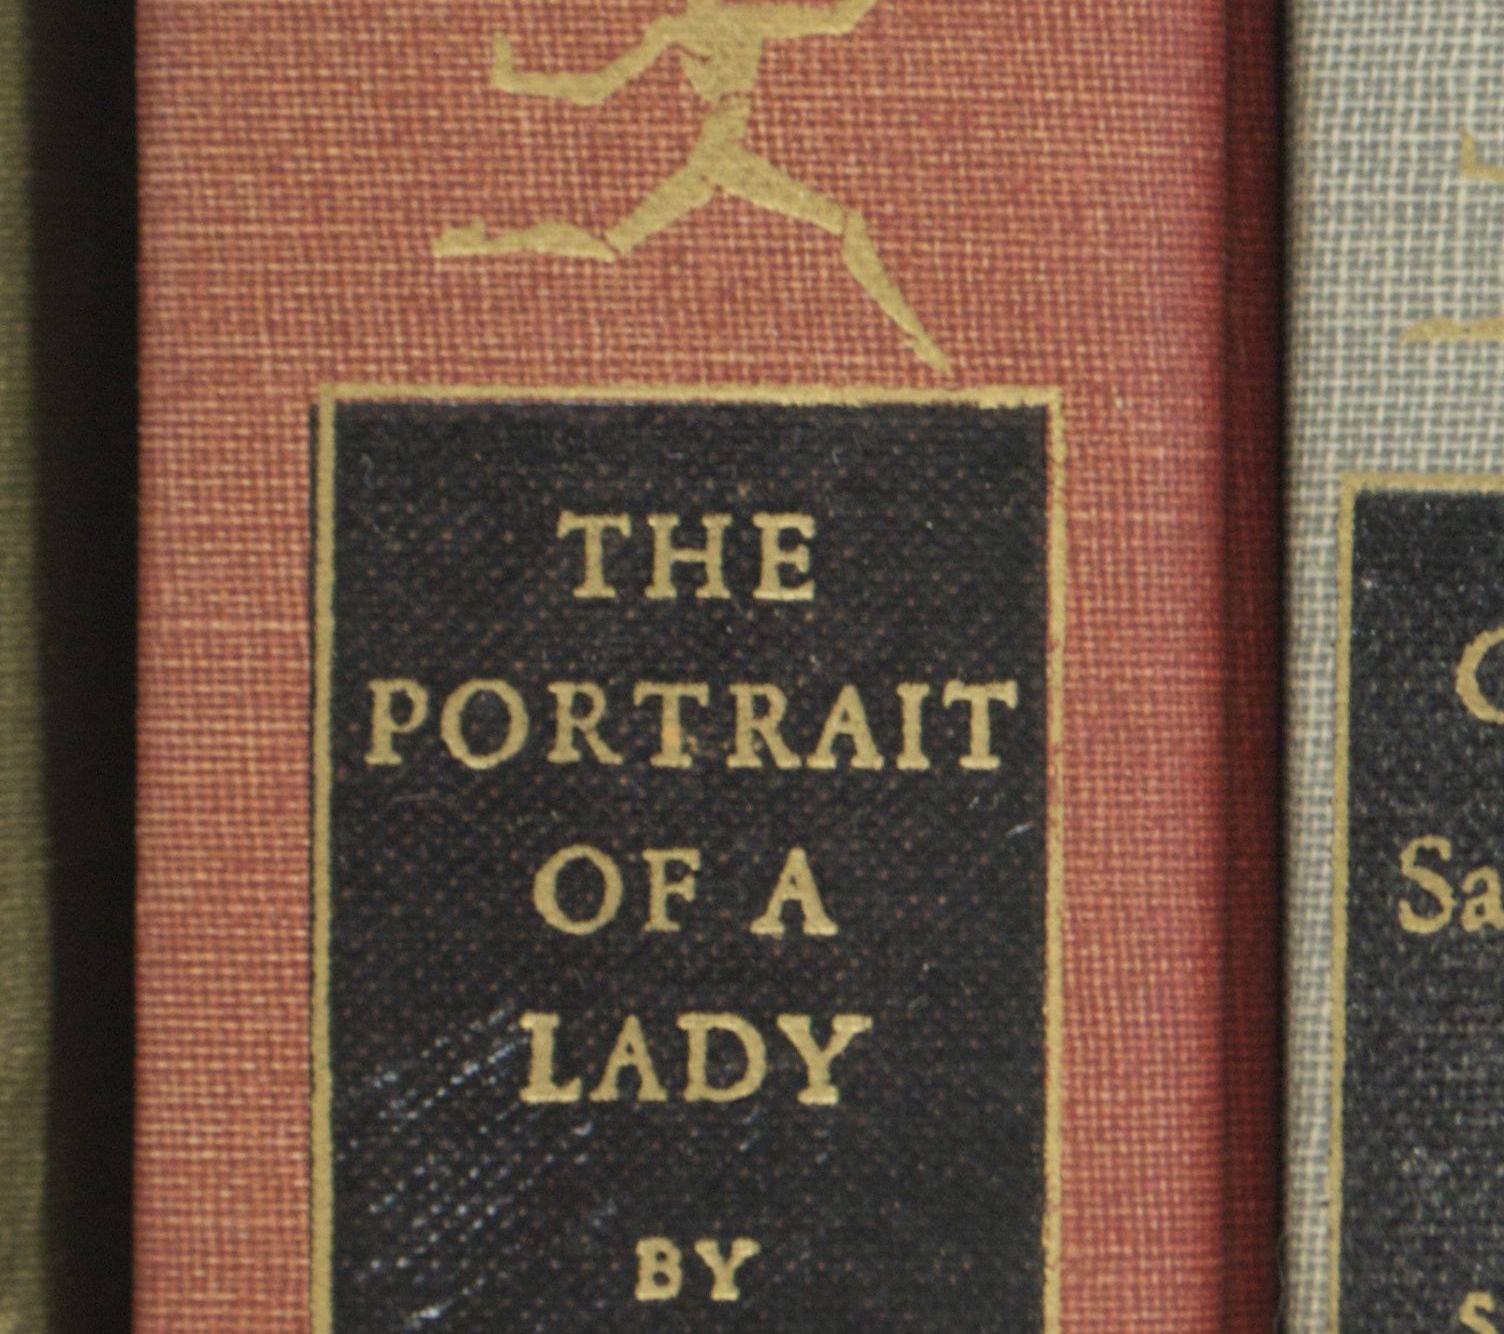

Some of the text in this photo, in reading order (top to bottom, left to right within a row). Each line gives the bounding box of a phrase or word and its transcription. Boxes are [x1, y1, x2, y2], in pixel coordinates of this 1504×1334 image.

[556, 510, 814, 601] THE
[365, 678, 1017, 770] PORTRAIT
[531, 843, 837, 938] OF A
[518, 1011, 871, 1105] LADY
[634, 1237, 759, 1301] BY
